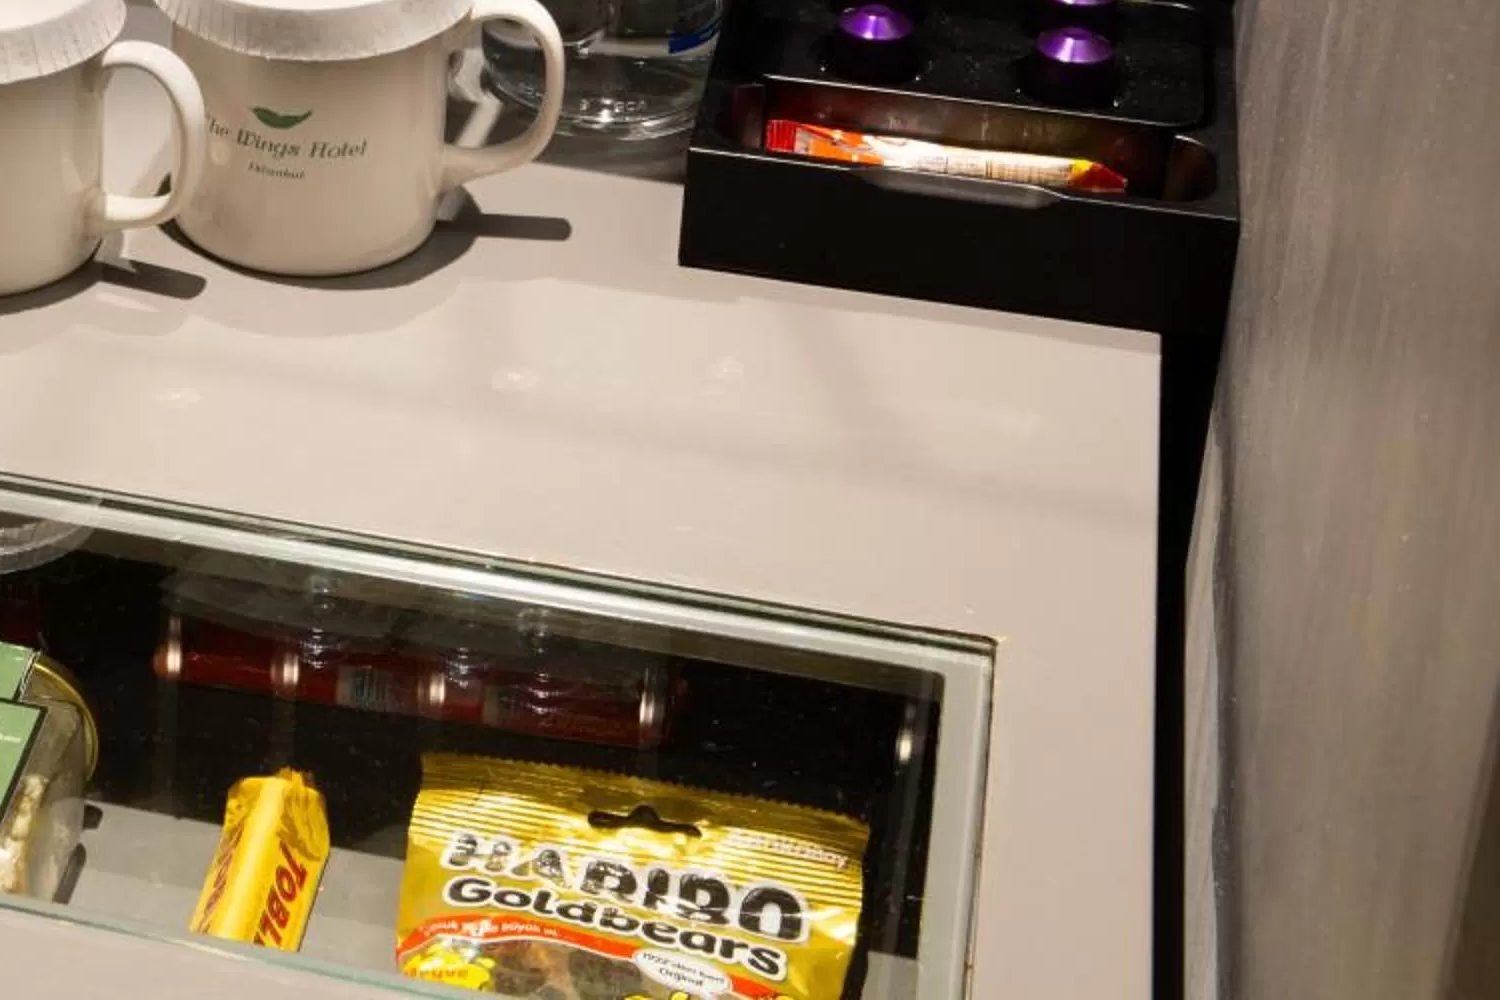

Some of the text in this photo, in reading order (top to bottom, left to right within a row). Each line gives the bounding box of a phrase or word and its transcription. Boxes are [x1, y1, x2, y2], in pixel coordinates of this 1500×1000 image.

[236, 127, 302, 158] Wings
[309, 138, 368, 159] Hotel
[448, 878, 781, 976] Goldbears
